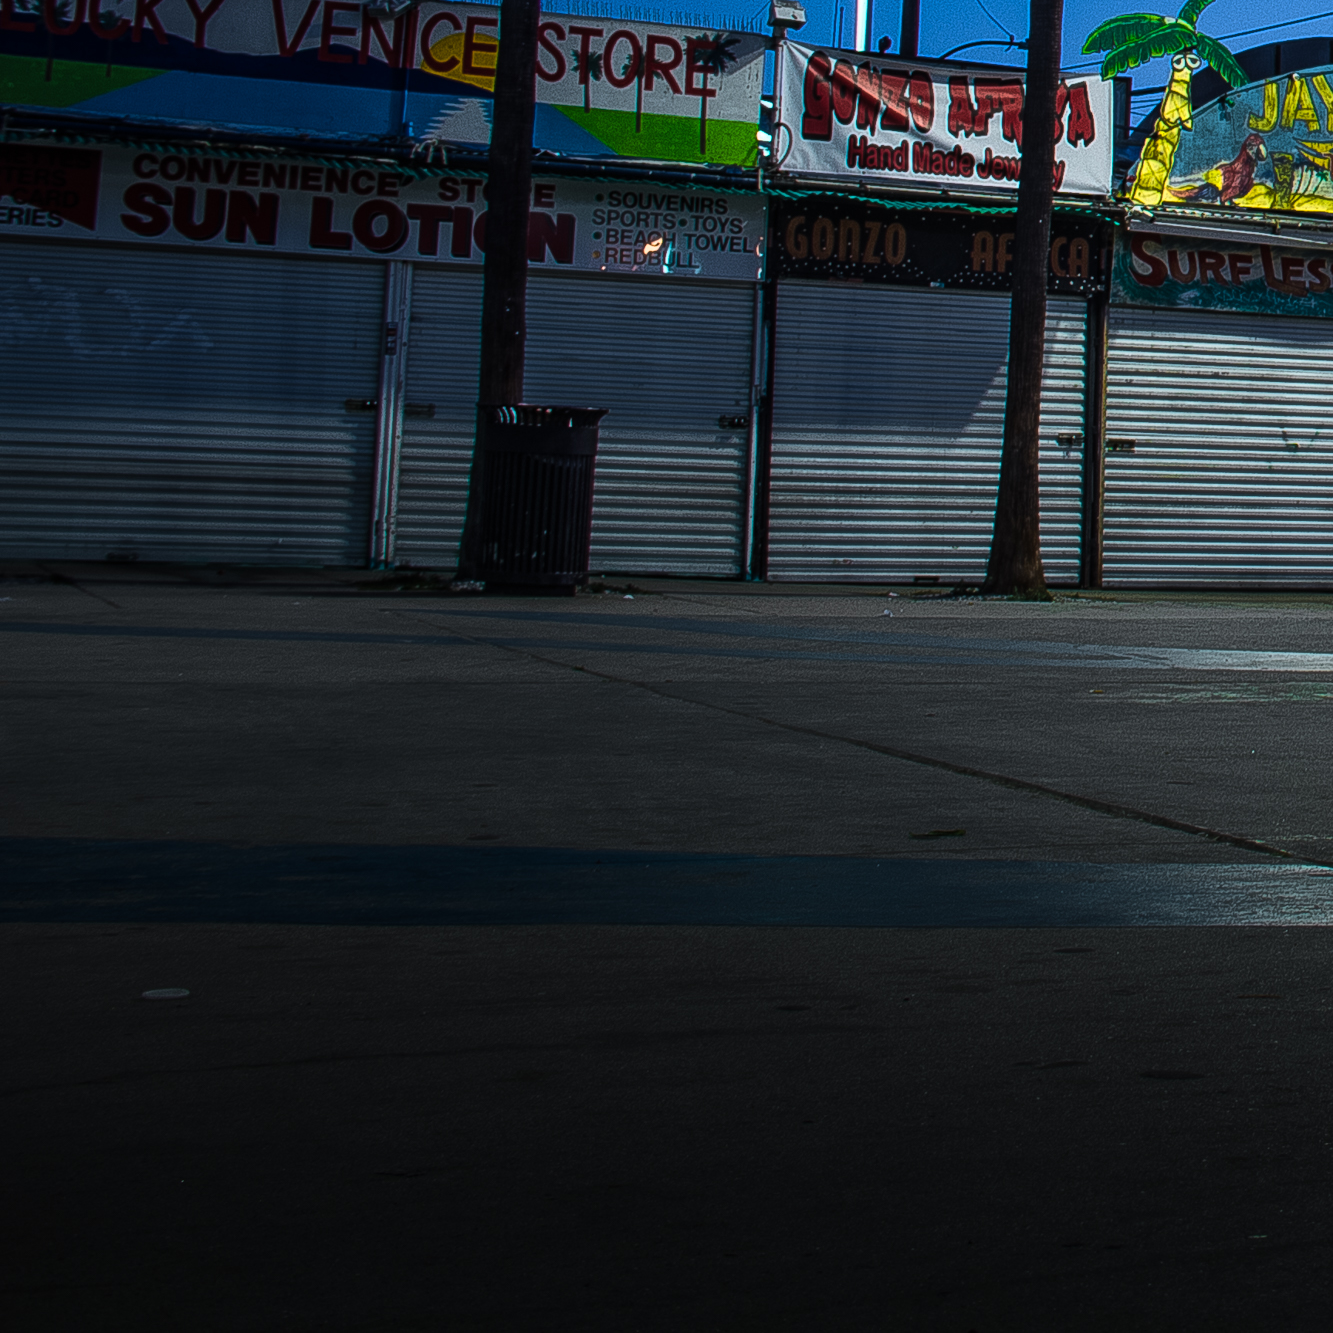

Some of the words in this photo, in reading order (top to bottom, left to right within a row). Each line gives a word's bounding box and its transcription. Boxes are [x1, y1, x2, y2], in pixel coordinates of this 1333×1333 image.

[535, 21, 718, 98] STORE
[801, 50, 935, 141] GONZO
[947, 75, 1096, 151] AFRA
[133, 153, 401, 197] CONVENIENCE
[438, 175, 557, 209] STE
[846, 134, 910, 171] Hand
[912, 141, 976, 177] Made
[976, 147, 1066, 192] Jewy
[11, 186, 80, 208] CARD
[121, 182, 280, 246] SUN
[309, 195, 577, 265] LOTIN
[592, 209, 676, 230] SPORTS
[691, 215, 744, 235] TOYS
[607, 190, 729, 215] SOUVENIRS
[604, 246, 700, 268] REDBULL
[605, 228, 677, 247] BEACH
[683, 233, 755, 253] TOWEL
[785, 216, 907, 265] GONZO
[970, 229, 1090, 278] AFCA
[1128, 233, 1253, 288] SURF
